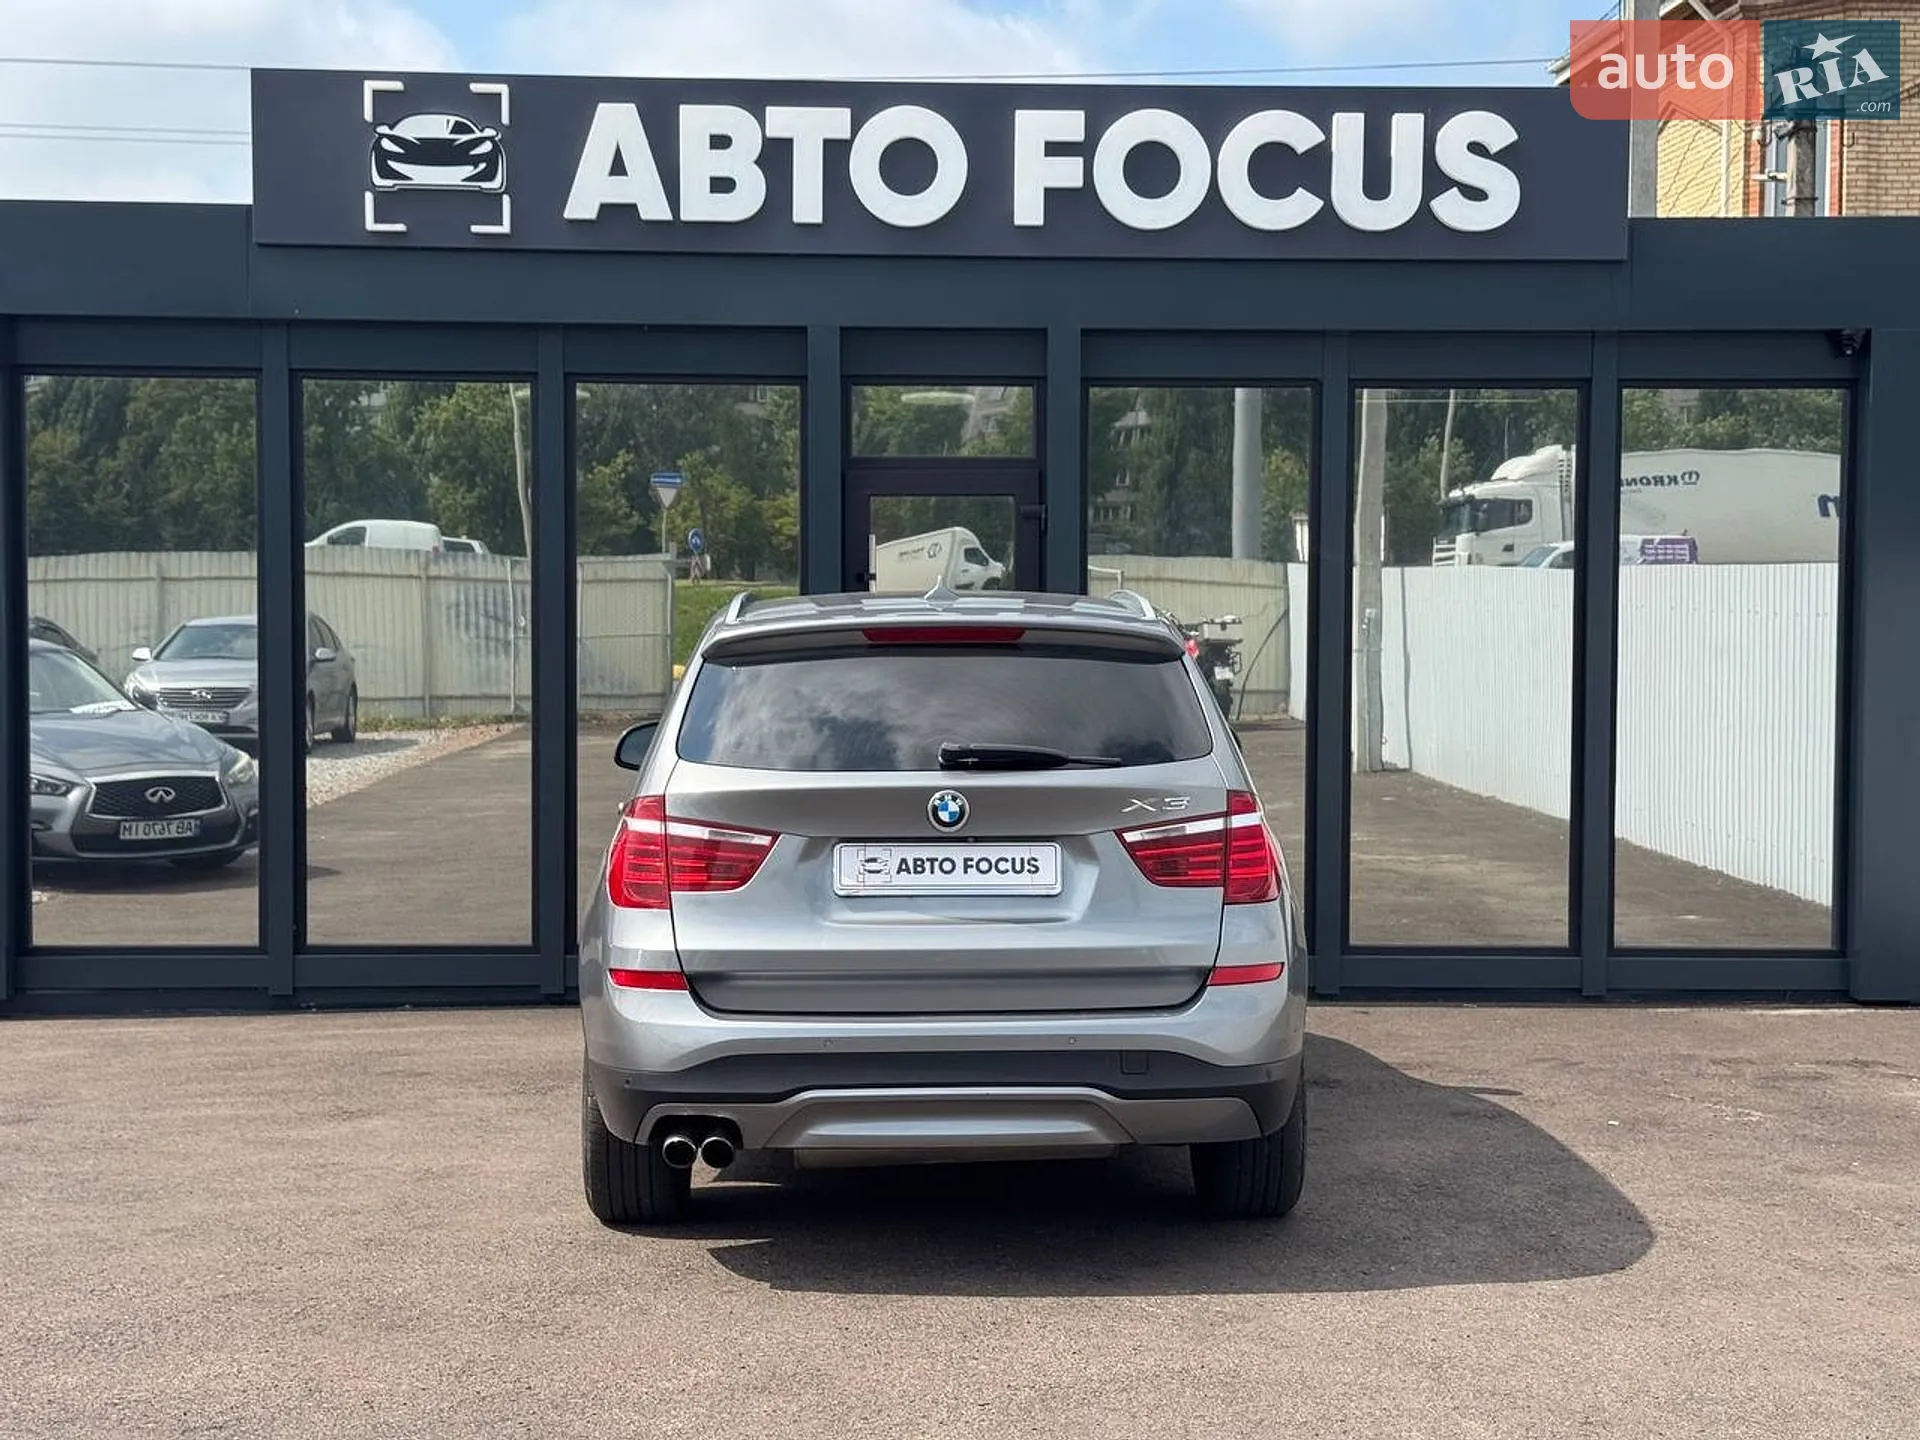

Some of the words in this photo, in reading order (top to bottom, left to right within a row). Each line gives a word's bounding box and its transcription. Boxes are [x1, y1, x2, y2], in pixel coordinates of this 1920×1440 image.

[563, 102, 968, 228] АВТО
[1013, 107, 1521, 232] FOCUS
[1120, 796, 1191, 813] X3
[895, 856, 957, 875] АВТО
[962, 856, 1041, 875] FOCUS
